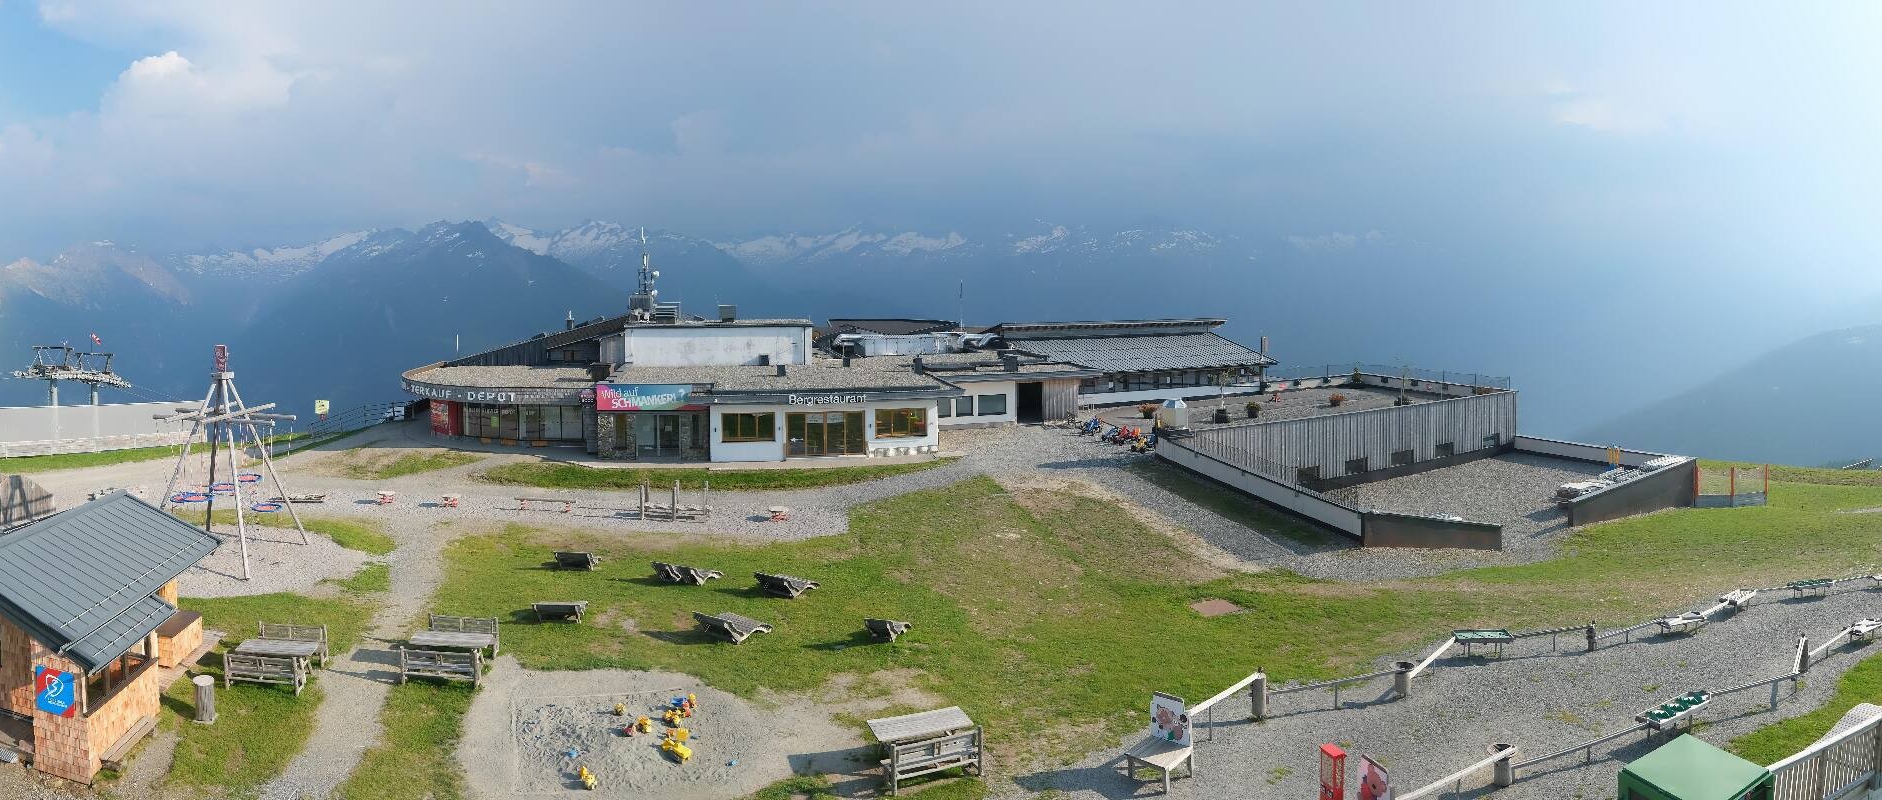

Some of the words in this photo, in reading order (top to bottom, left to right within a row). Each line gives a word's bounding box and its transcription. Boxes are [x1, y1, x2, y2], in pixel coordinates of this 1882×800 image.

[467, 391, 516, 402] DEPOT
[601, 387, 622, 399] Wild
[623, 386, 639, 398] auf
[788, 394, 867, 407] Bergrestaurant
